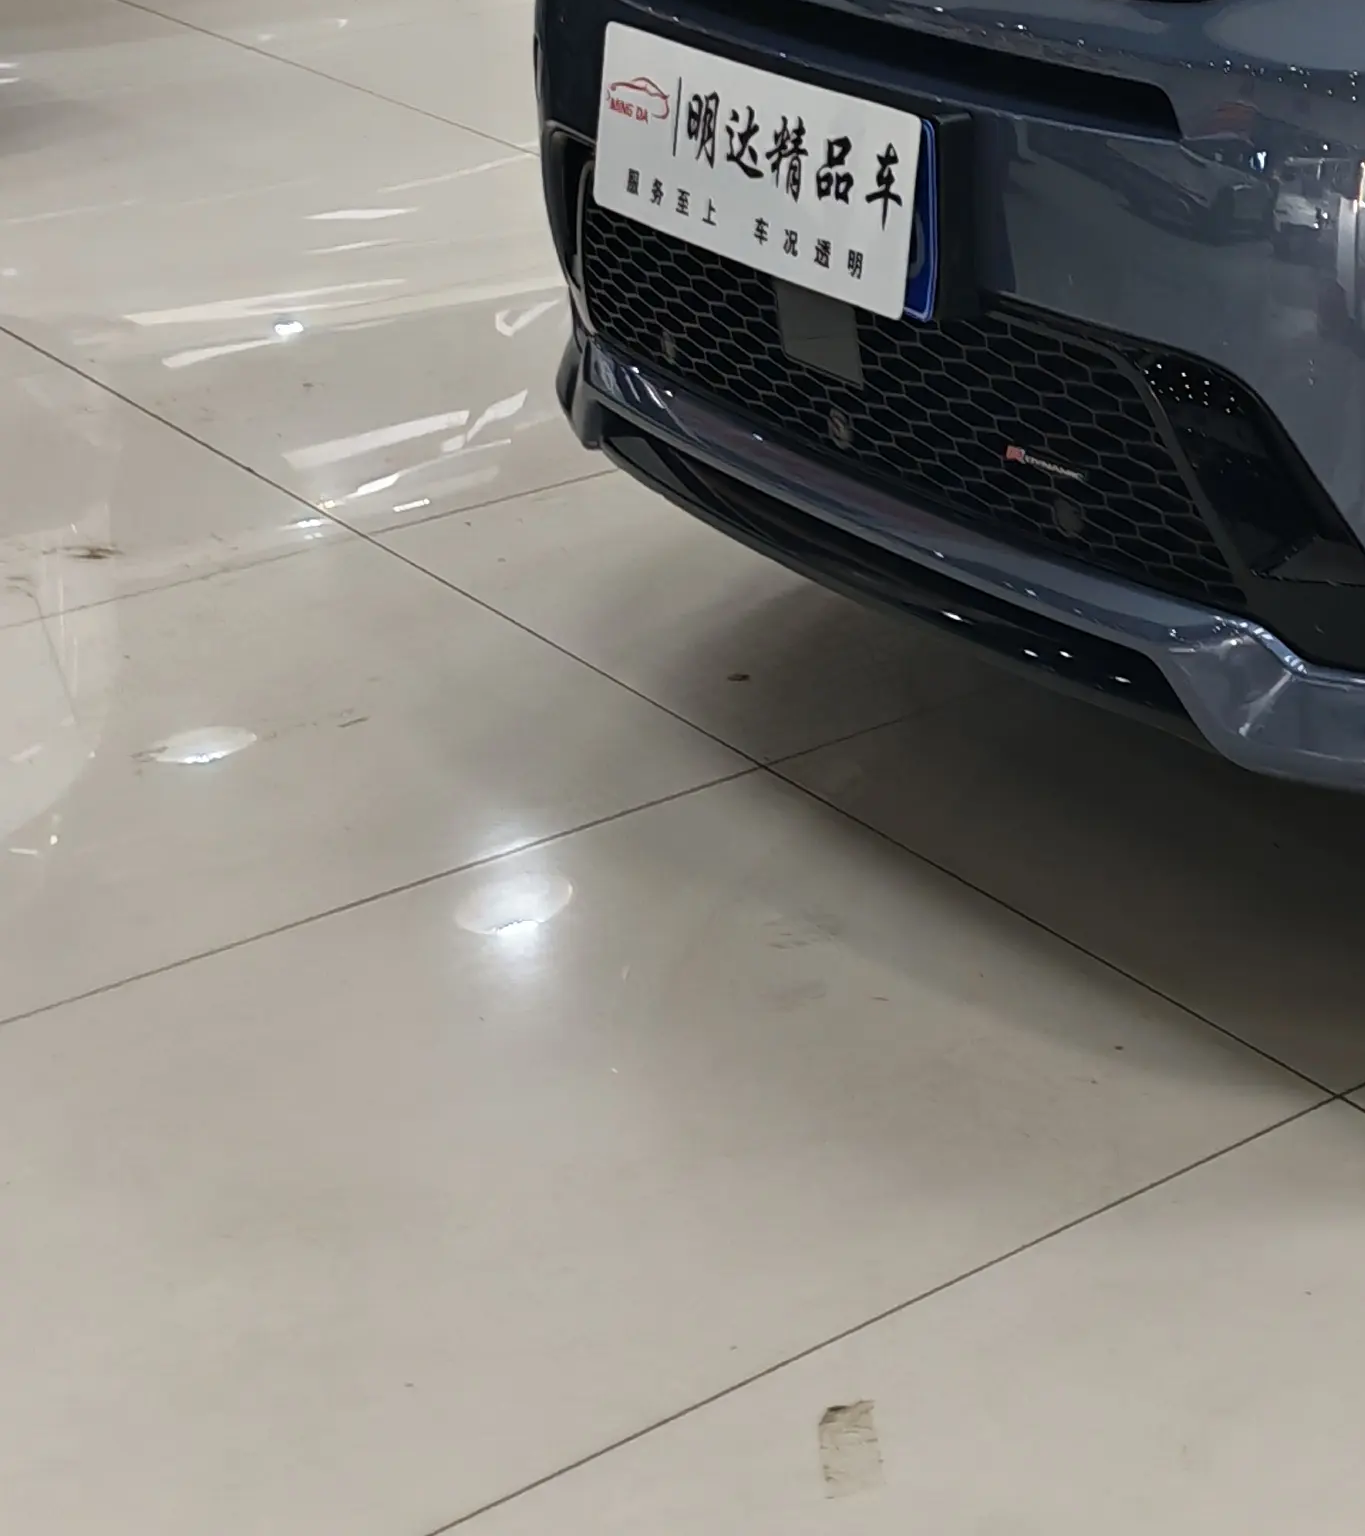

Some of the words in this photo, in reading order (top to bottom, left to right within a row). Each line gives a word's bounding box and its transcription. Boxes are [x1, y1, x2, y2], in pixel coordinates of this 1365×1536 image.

[625, 167, 717, 227] 服务至上
[753, 217, 864, 280] 车况透明
[686, 90, 903, 231] 明达精品车
